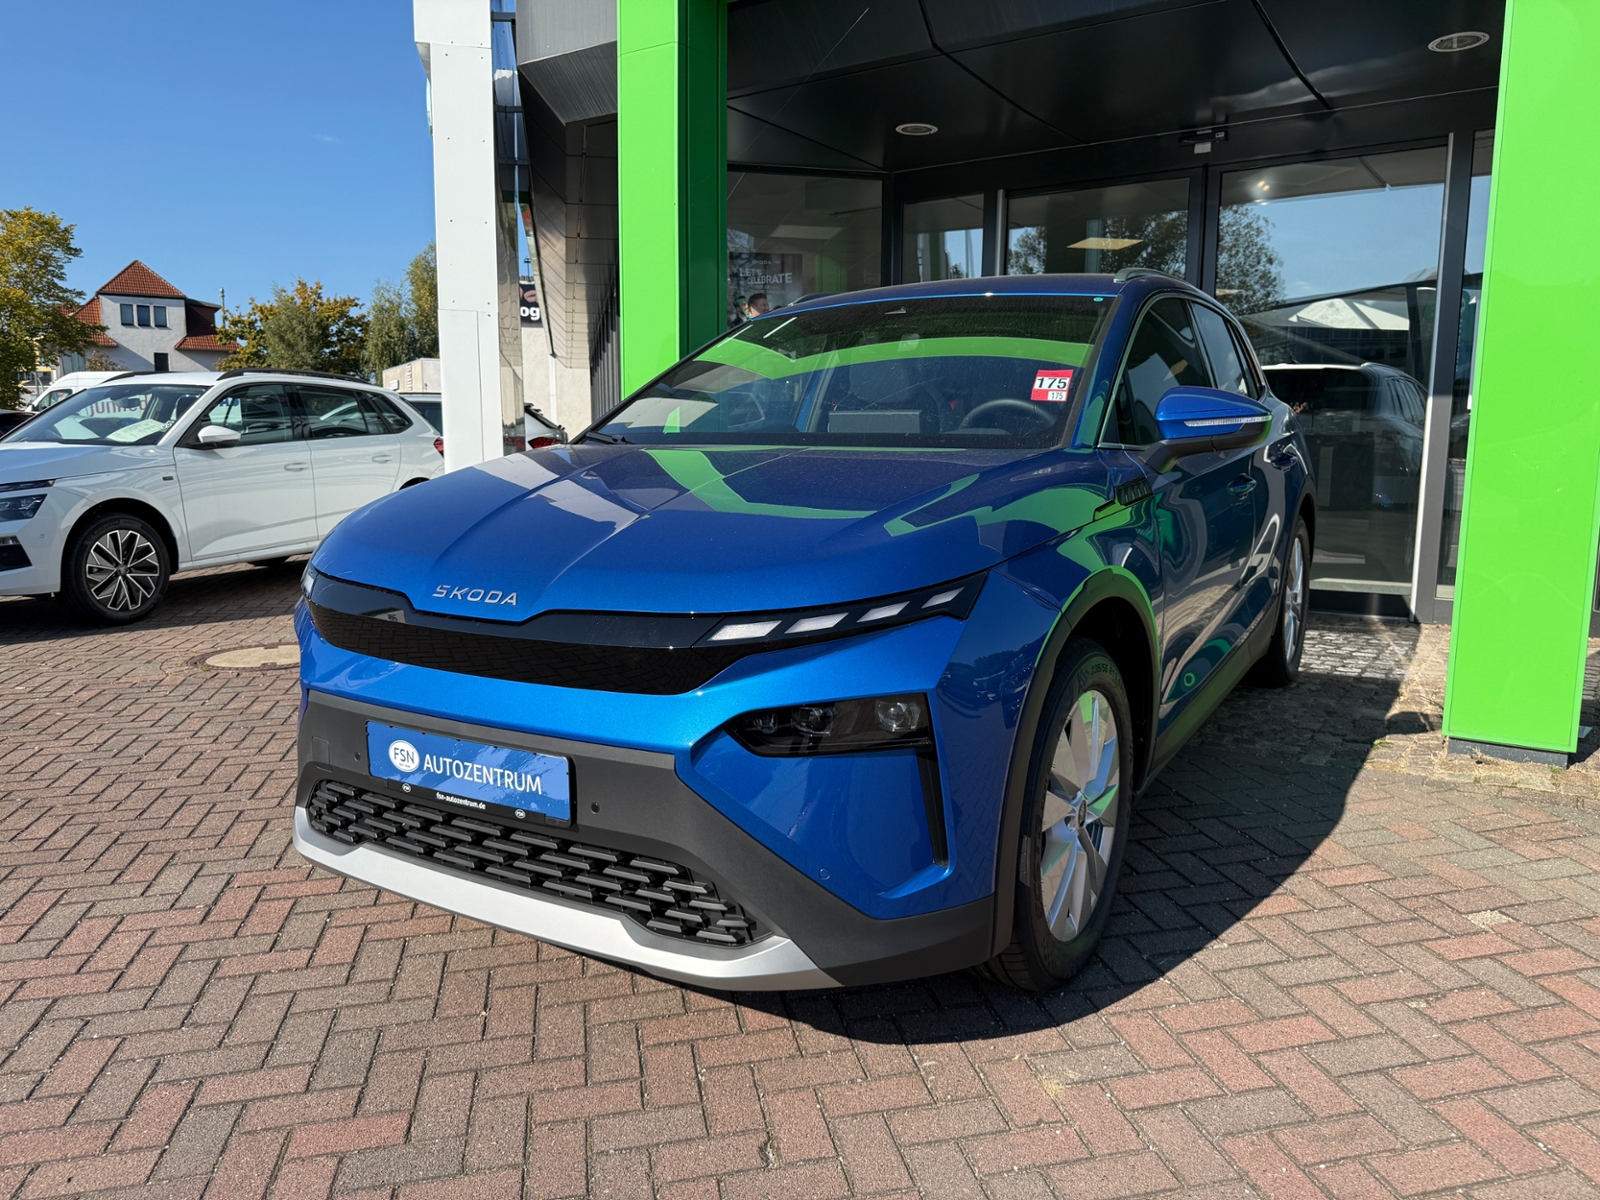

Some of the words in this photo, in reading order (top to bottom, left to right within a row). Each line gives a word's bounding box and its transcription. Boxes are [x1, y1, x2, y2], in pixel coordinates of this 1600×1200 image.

[739, 268, 762, 277] LET'S
[747, 273, 792, 284] CELEBRATE
[1037, 377, 1067, 389] 175
[1051, 392, 1063, 400] 175
[393, 747, 415, 764] FSN
[423, 754, 542, 795] AUTOZENTRUM
[436, 792, 486, 810] fsn-autozentrum.de
